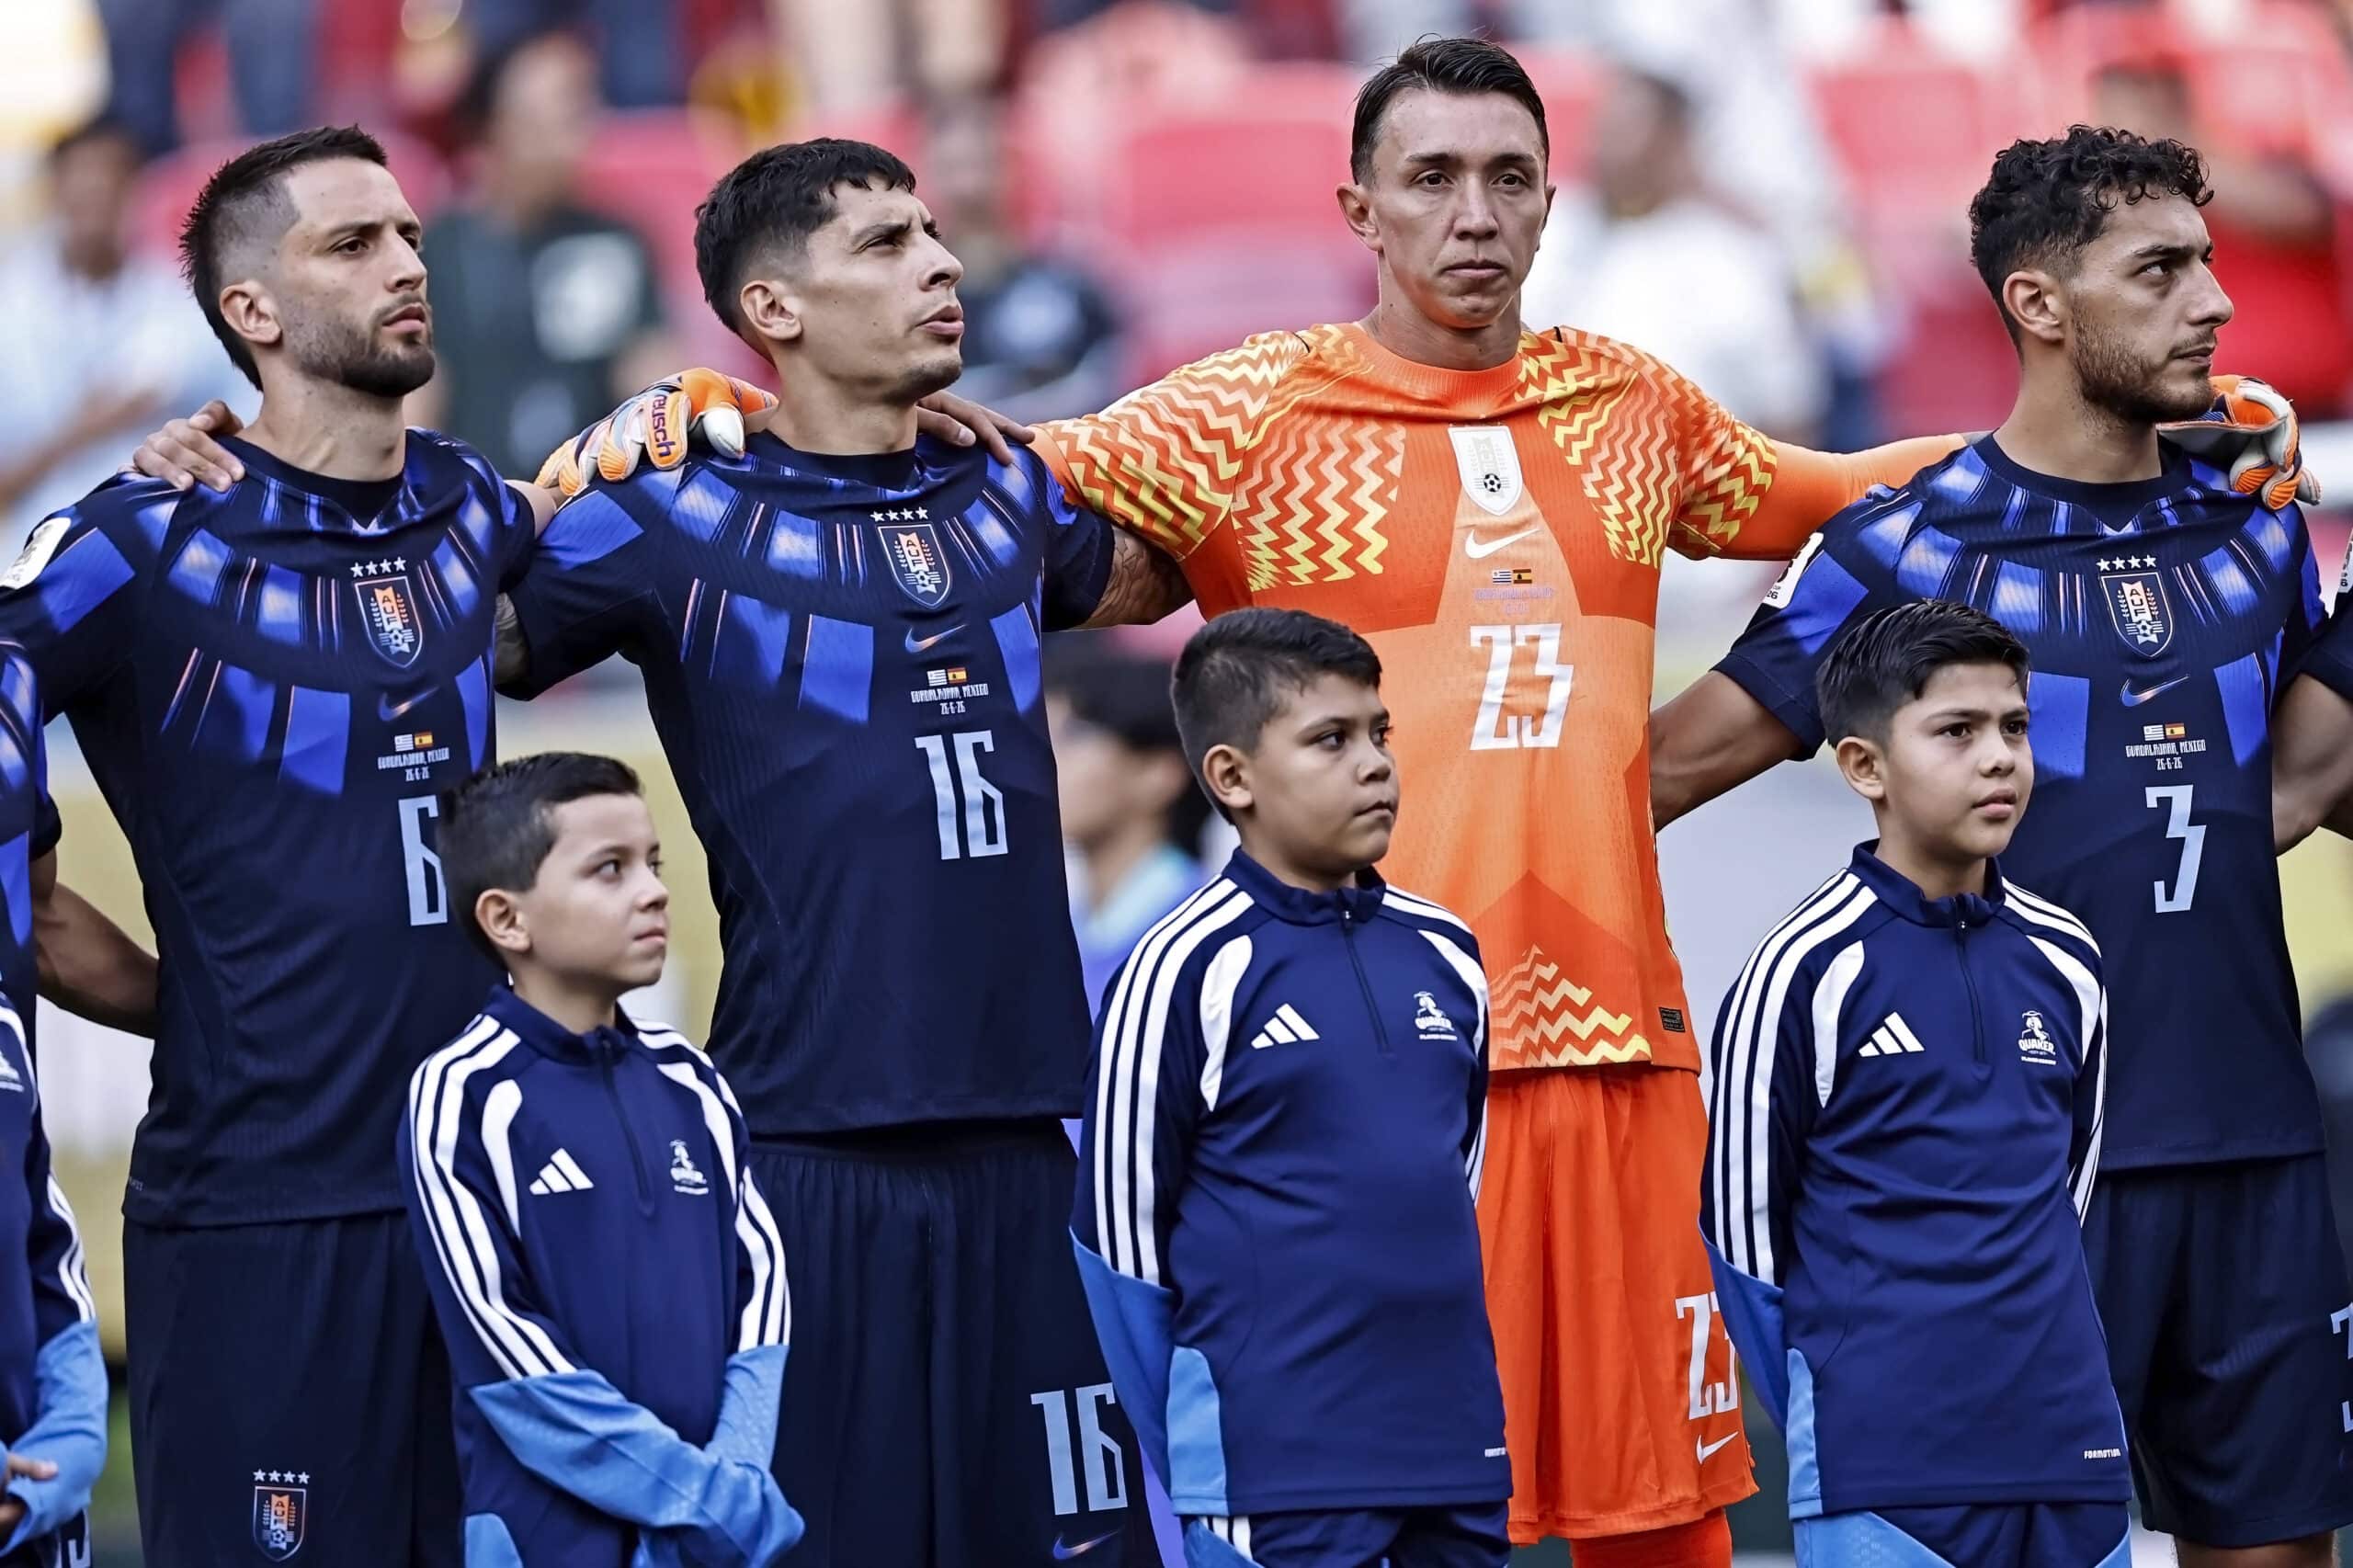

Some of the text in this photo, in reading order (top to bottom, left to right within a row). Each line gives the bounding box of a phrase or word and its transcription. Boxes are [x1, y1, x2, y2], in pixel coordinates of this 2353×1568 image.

[652, 394, 676, 457] reusch
[905, 539, 924, 567] AUF
[381, 595, 398, 626] AUF
[2129, 588, 2146, 617] AUF
[1470, 622, 1574, 751] 23
[915, 729, 1009, 860] 16
[398, 794, 448, 926] 6
[2145, 784, 2207, 914] 3
[2018, 1038, 2055, 1054] QUAKER
[1030, 1382, 1129, 1516] 16
